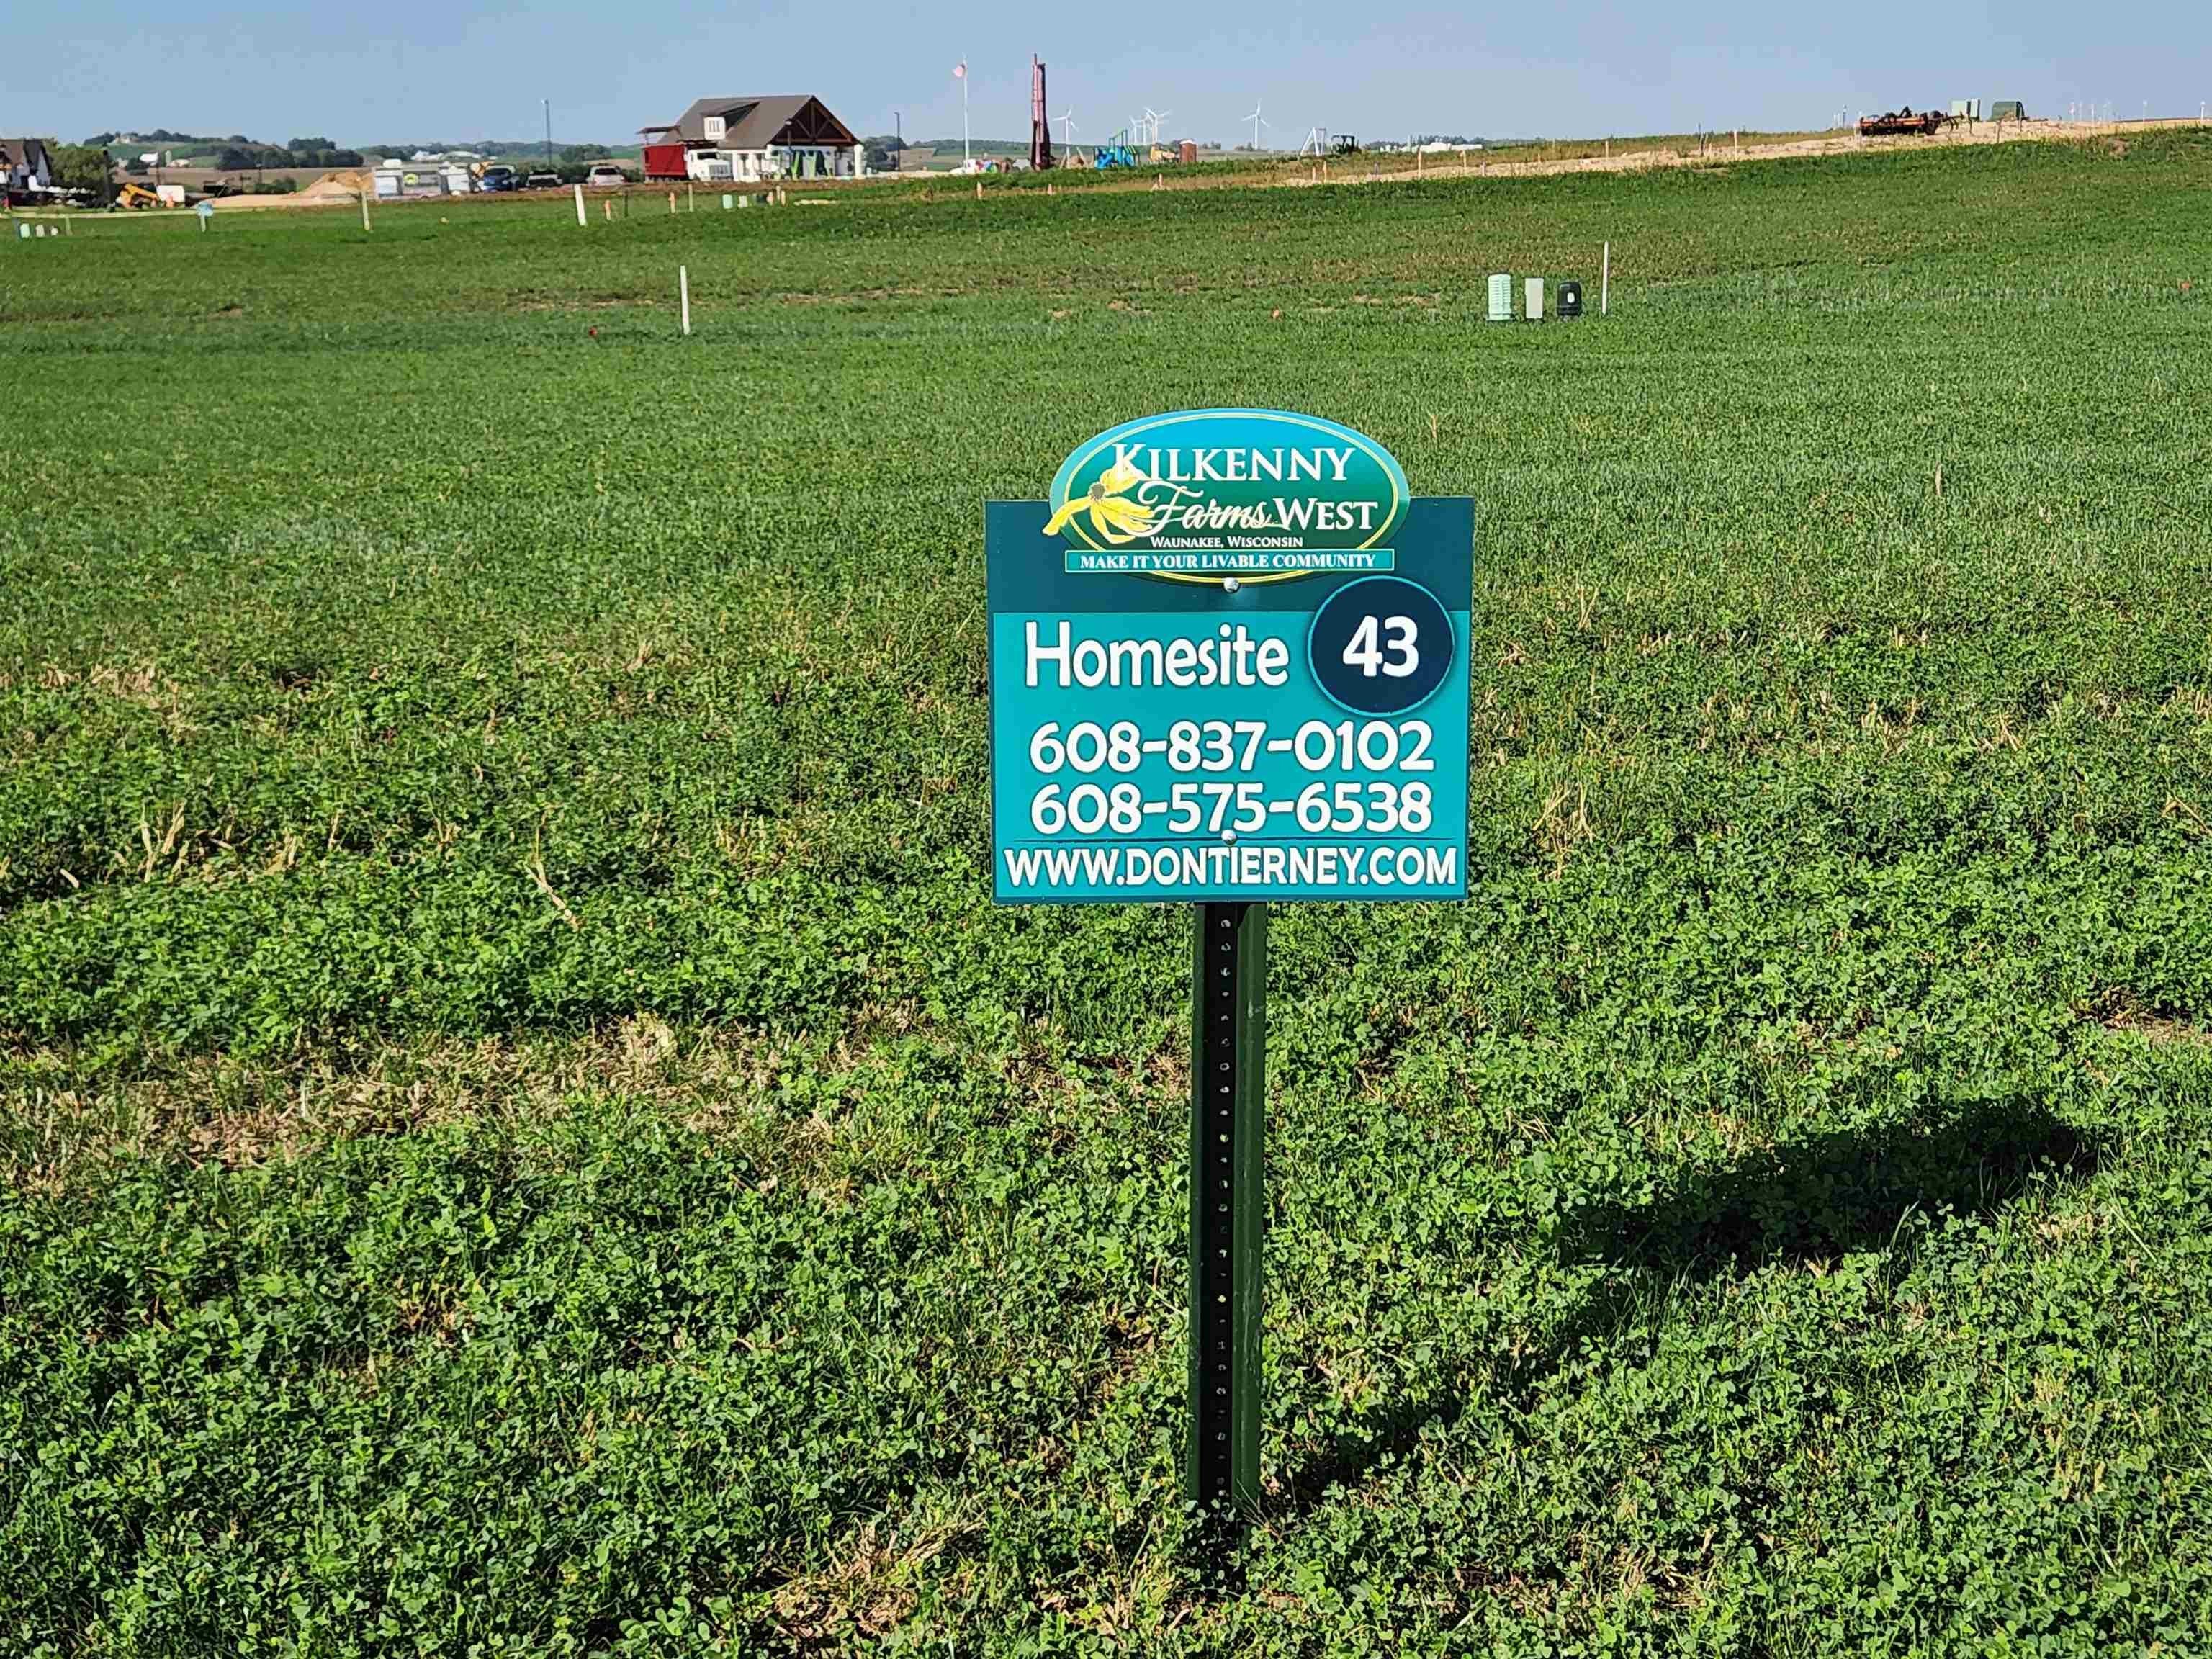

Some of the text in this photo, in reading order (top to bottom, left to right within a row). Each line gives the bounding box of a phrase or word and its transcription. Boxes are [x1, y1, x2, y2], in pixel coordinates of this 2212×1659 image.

[1111, 443, 1357, 482] KILKENNY
[1137, 480, 1378, 536] Farms WEST
[1080, 553, 1377, 569] MAKE IT YOUR LIVABLE COMMUNITY
[1149, 535, 1304, 549] WAUNAKEE, WISCONSIN
[1025, 615, 1419, 688] Homesite 43
[1029, 720, 1435, 774] 608-837-0102
[1030, 781, 1433, 835] 608-575-6538
[1004, 846, 1457, 887] WWW.DONTIERNEY.COM
